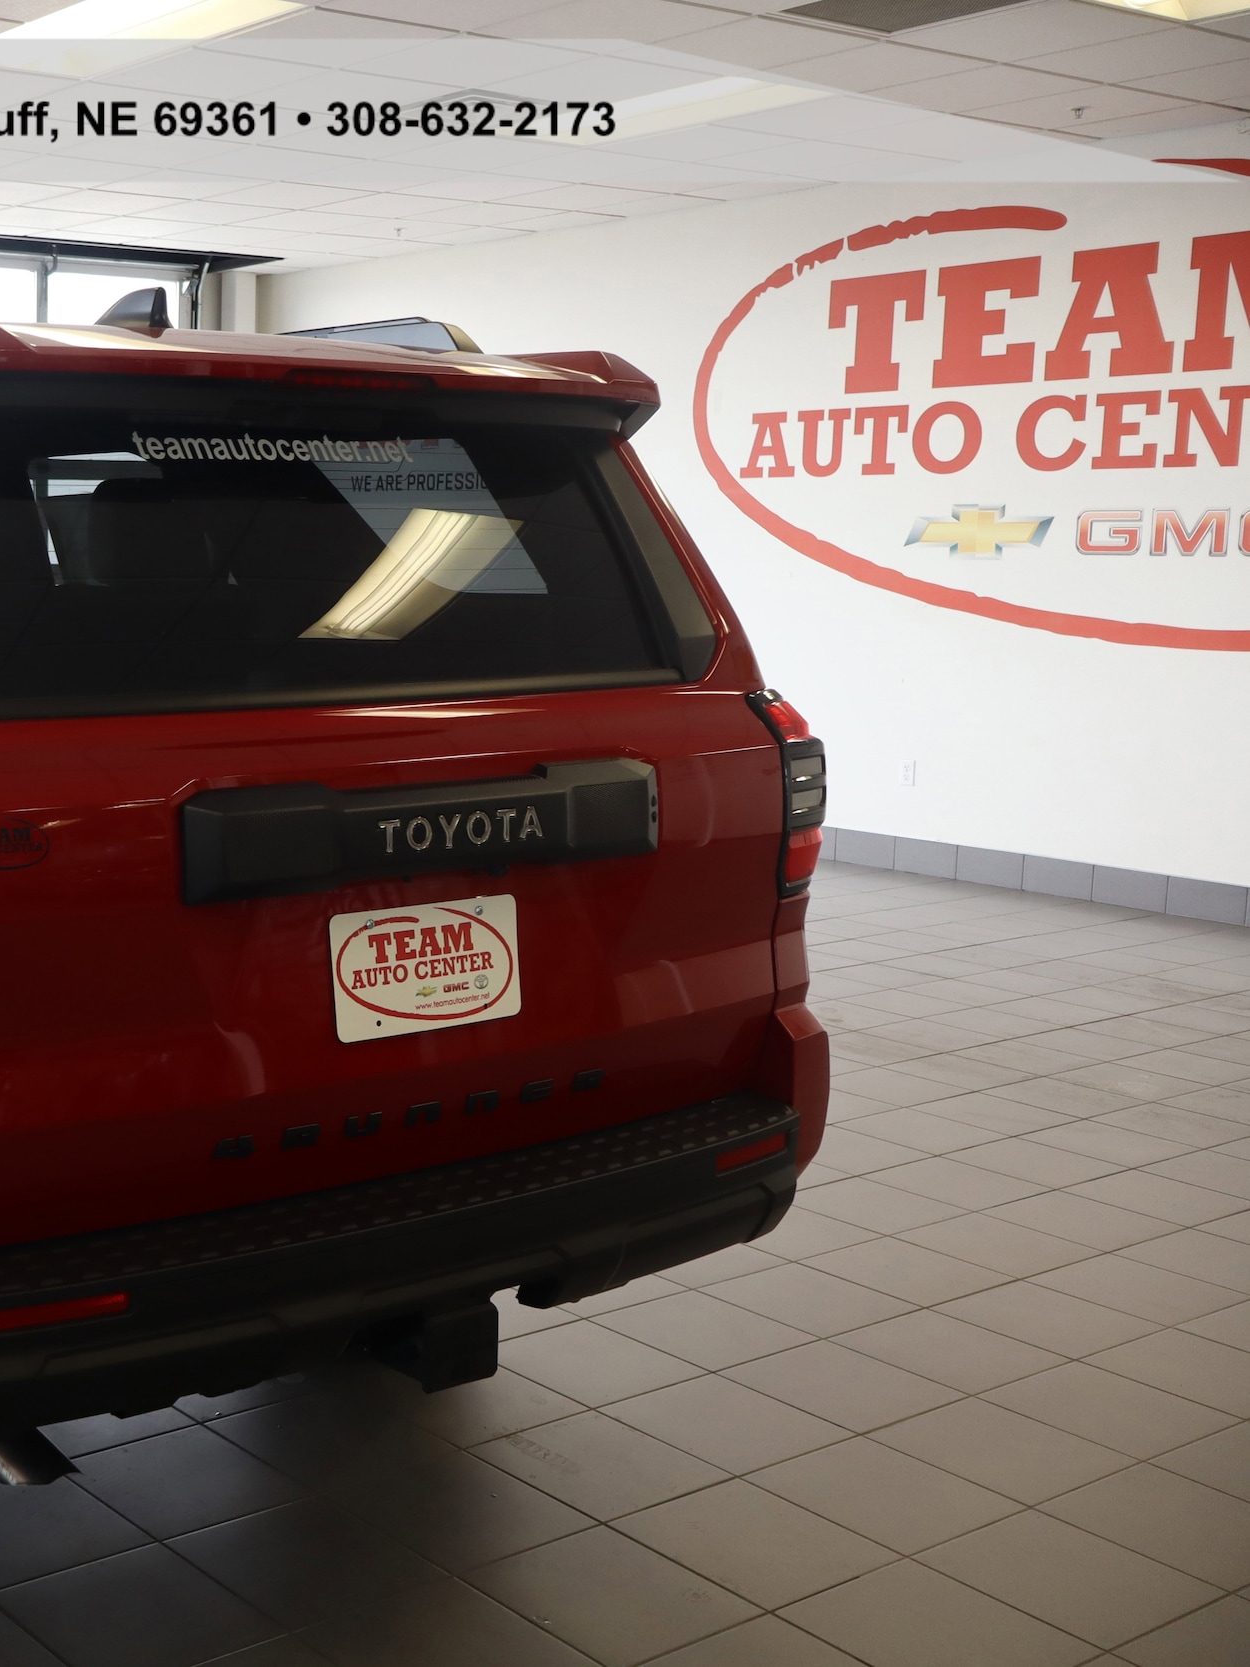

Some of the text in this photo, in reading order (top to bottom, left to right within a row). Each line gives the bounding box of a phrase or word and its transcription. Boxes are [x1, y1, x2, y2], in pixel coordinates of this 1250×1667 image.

[132, 430, 414, 463] teamautocenter.net
[740, 401, 982, 478] AUTO
[351, 475, 372, 493] WE
[376, 474, 403, 493] ARE
[378, 805, 544, 853] TOYOTA
[368, 921, 475, 964] TEAM
[351, 951, 494, 990] AUTO CENTER
[443, 981, 471, 994] GMC
[415, 991, 491, 1011] www.teamautocenter.net
